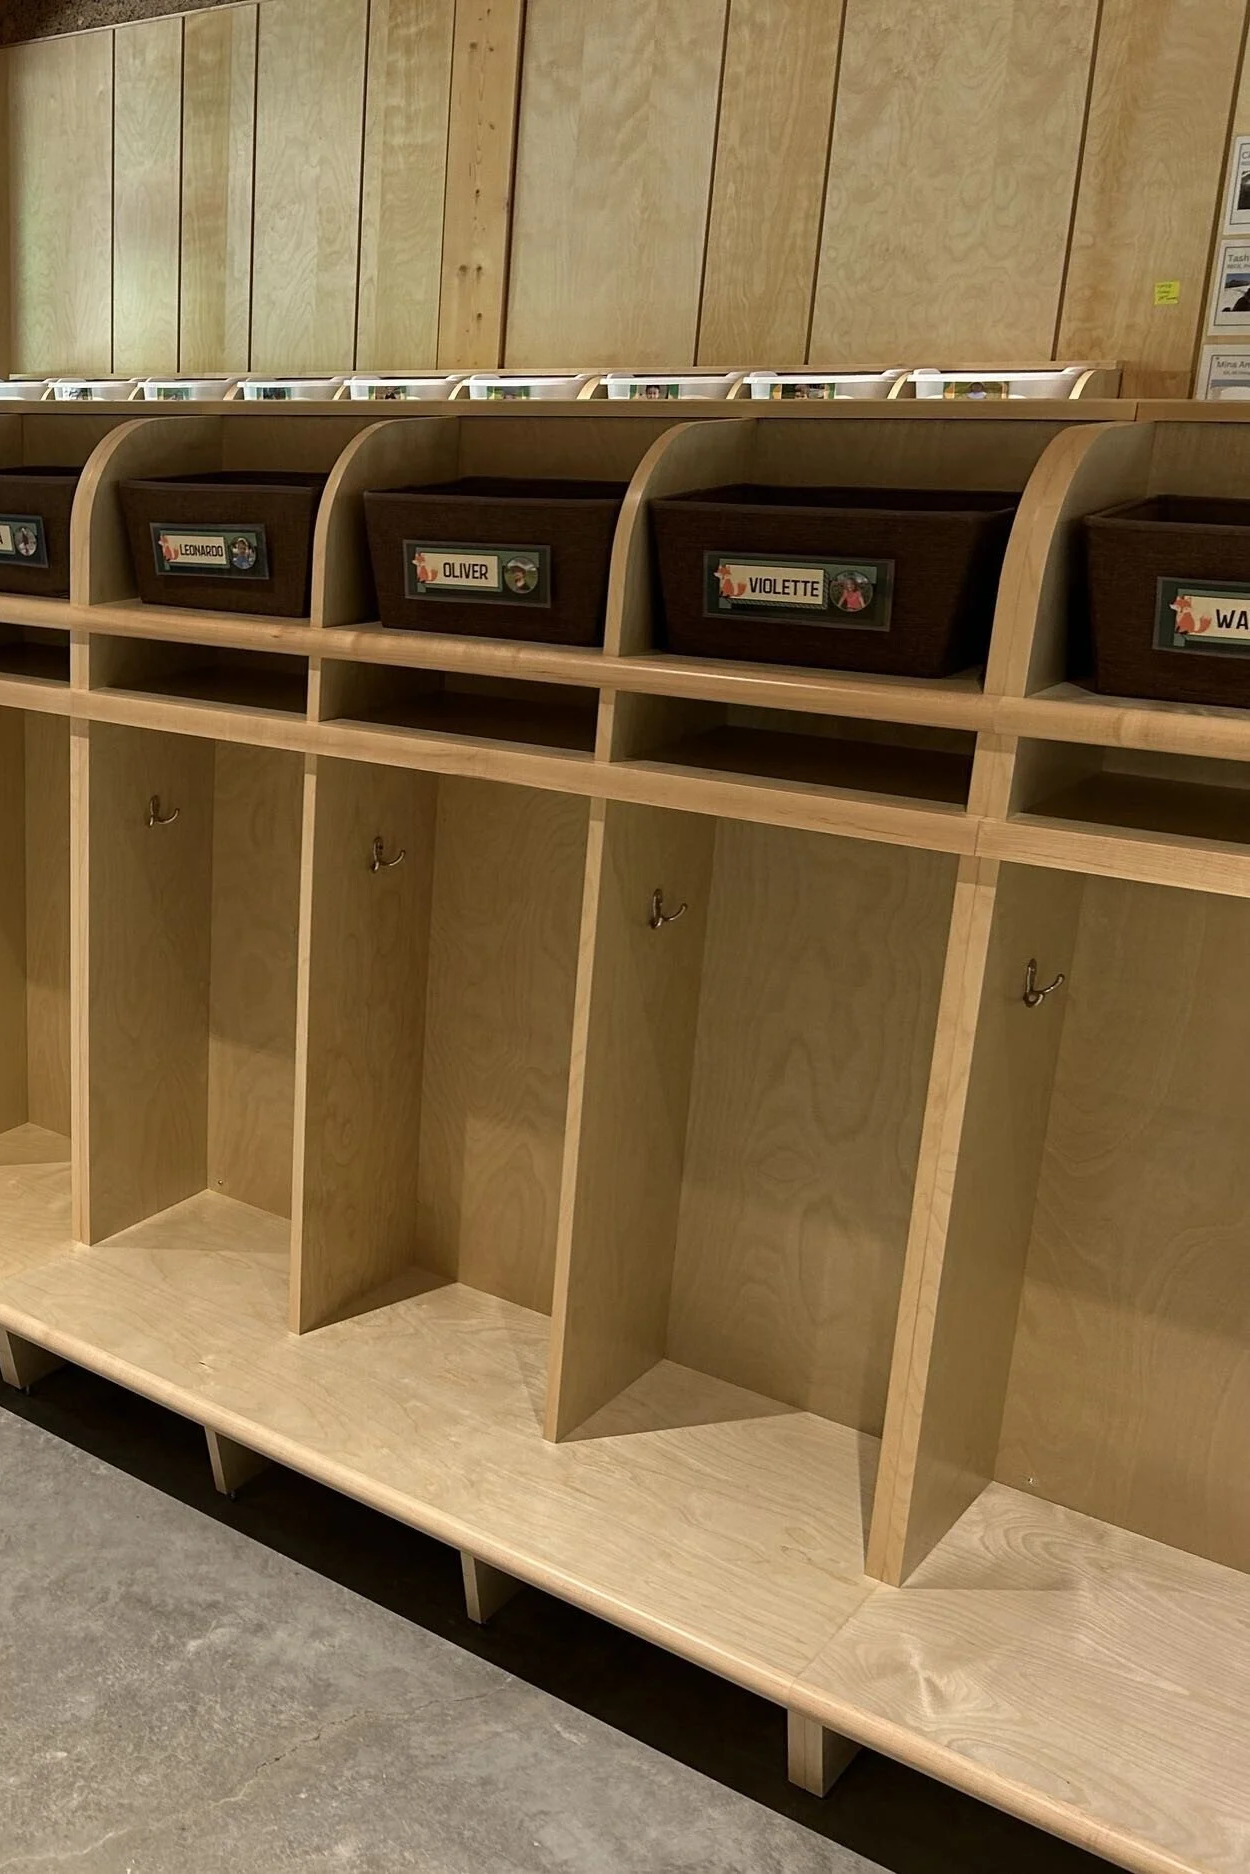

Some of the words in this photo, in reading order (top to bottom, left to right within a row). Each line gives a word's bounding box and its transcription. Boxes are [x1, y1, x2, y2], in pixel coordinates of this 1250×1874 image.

[179, 543, 224, 557] LEONARDO
[443, 562, 488, 580] OLIVER
[749, 577, 820, 597] VIOLETTE
[1216, 609, 1249, 630] WA
